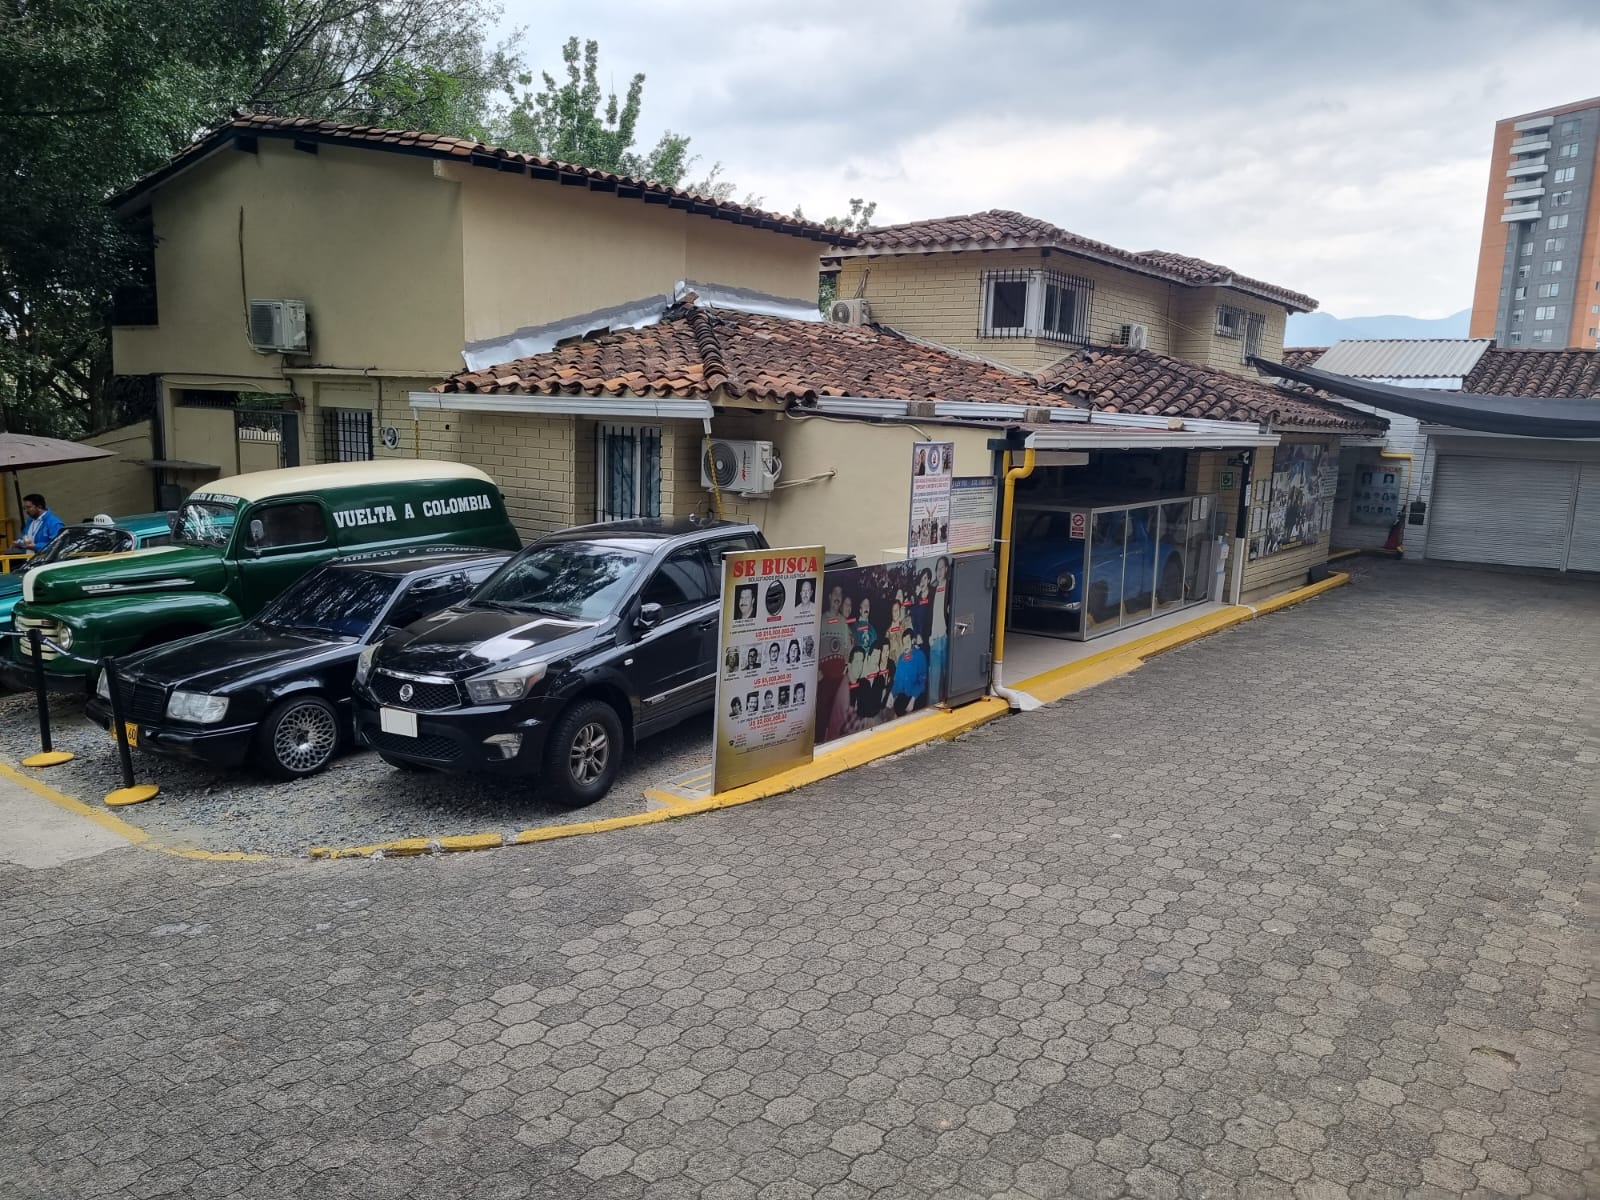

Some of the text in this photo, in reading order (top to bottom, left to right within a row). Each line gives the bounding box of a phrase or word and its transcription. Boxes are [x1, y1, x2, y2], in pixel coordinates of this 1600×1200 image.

[333, 494, 492, 529] VUELTA A COLOMBIA
[732, 556, 818, 578] SE BUSCA
